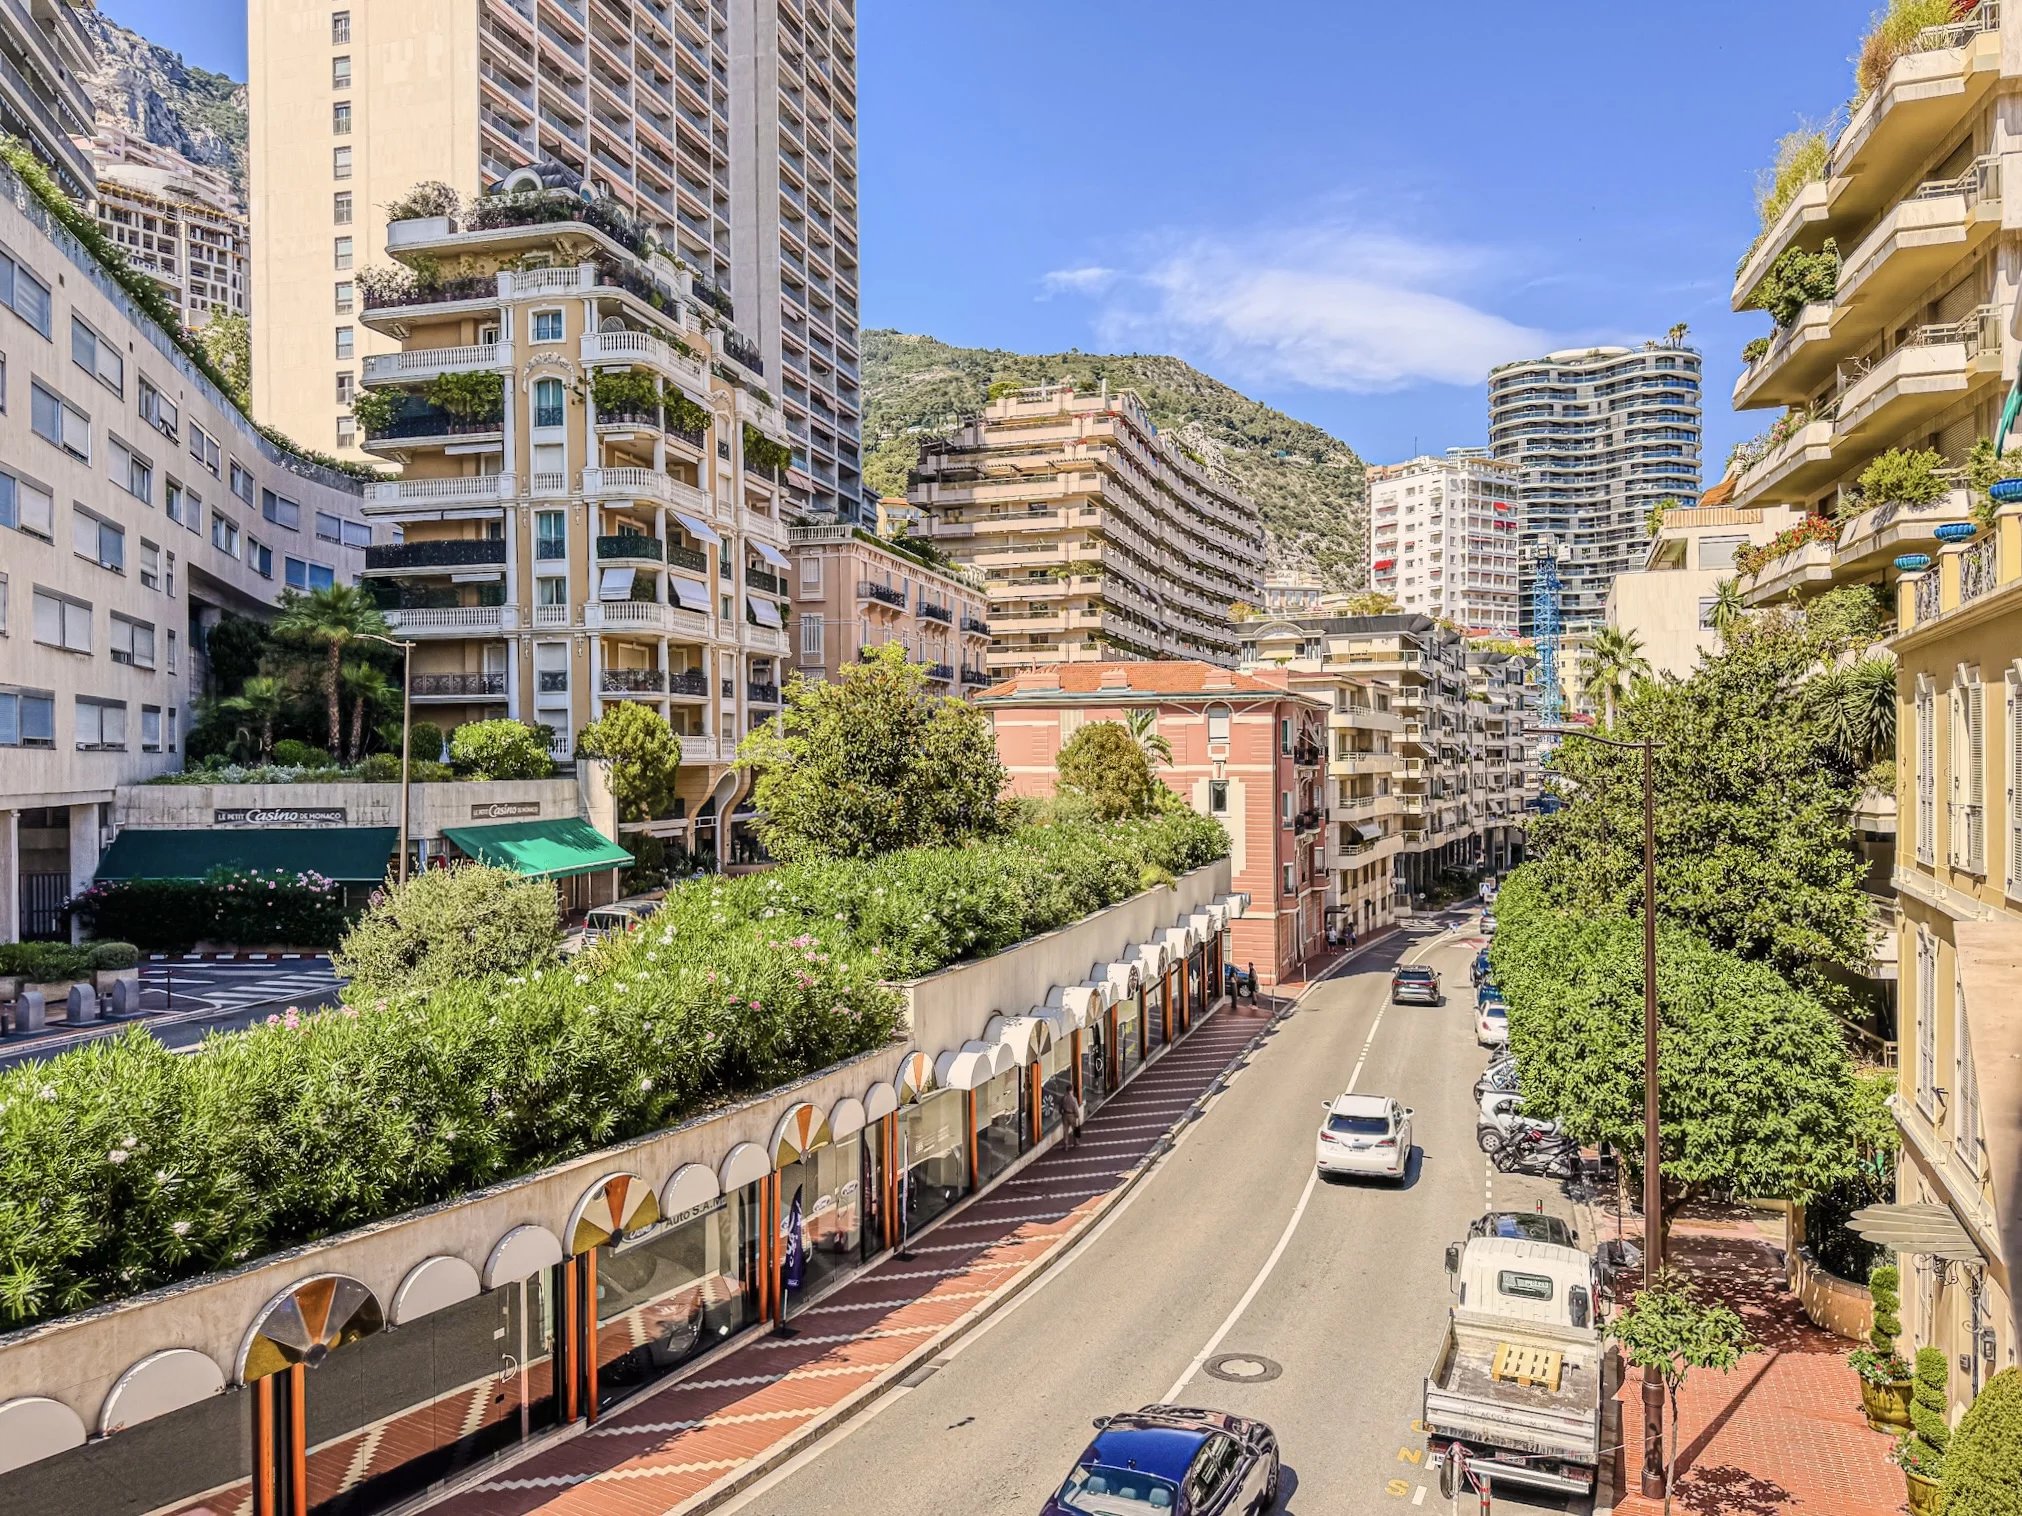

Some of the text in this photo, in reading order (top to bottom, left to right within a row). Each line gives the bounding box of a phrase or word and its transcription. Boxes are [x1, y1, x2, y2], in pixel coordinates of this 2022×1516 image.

[245, 809, 299, 824] Casino
[309, 812, 342, 820] MONACO
[489, 804, 517, 817] Casino
[665, 1210, 690, 1227] Auto
